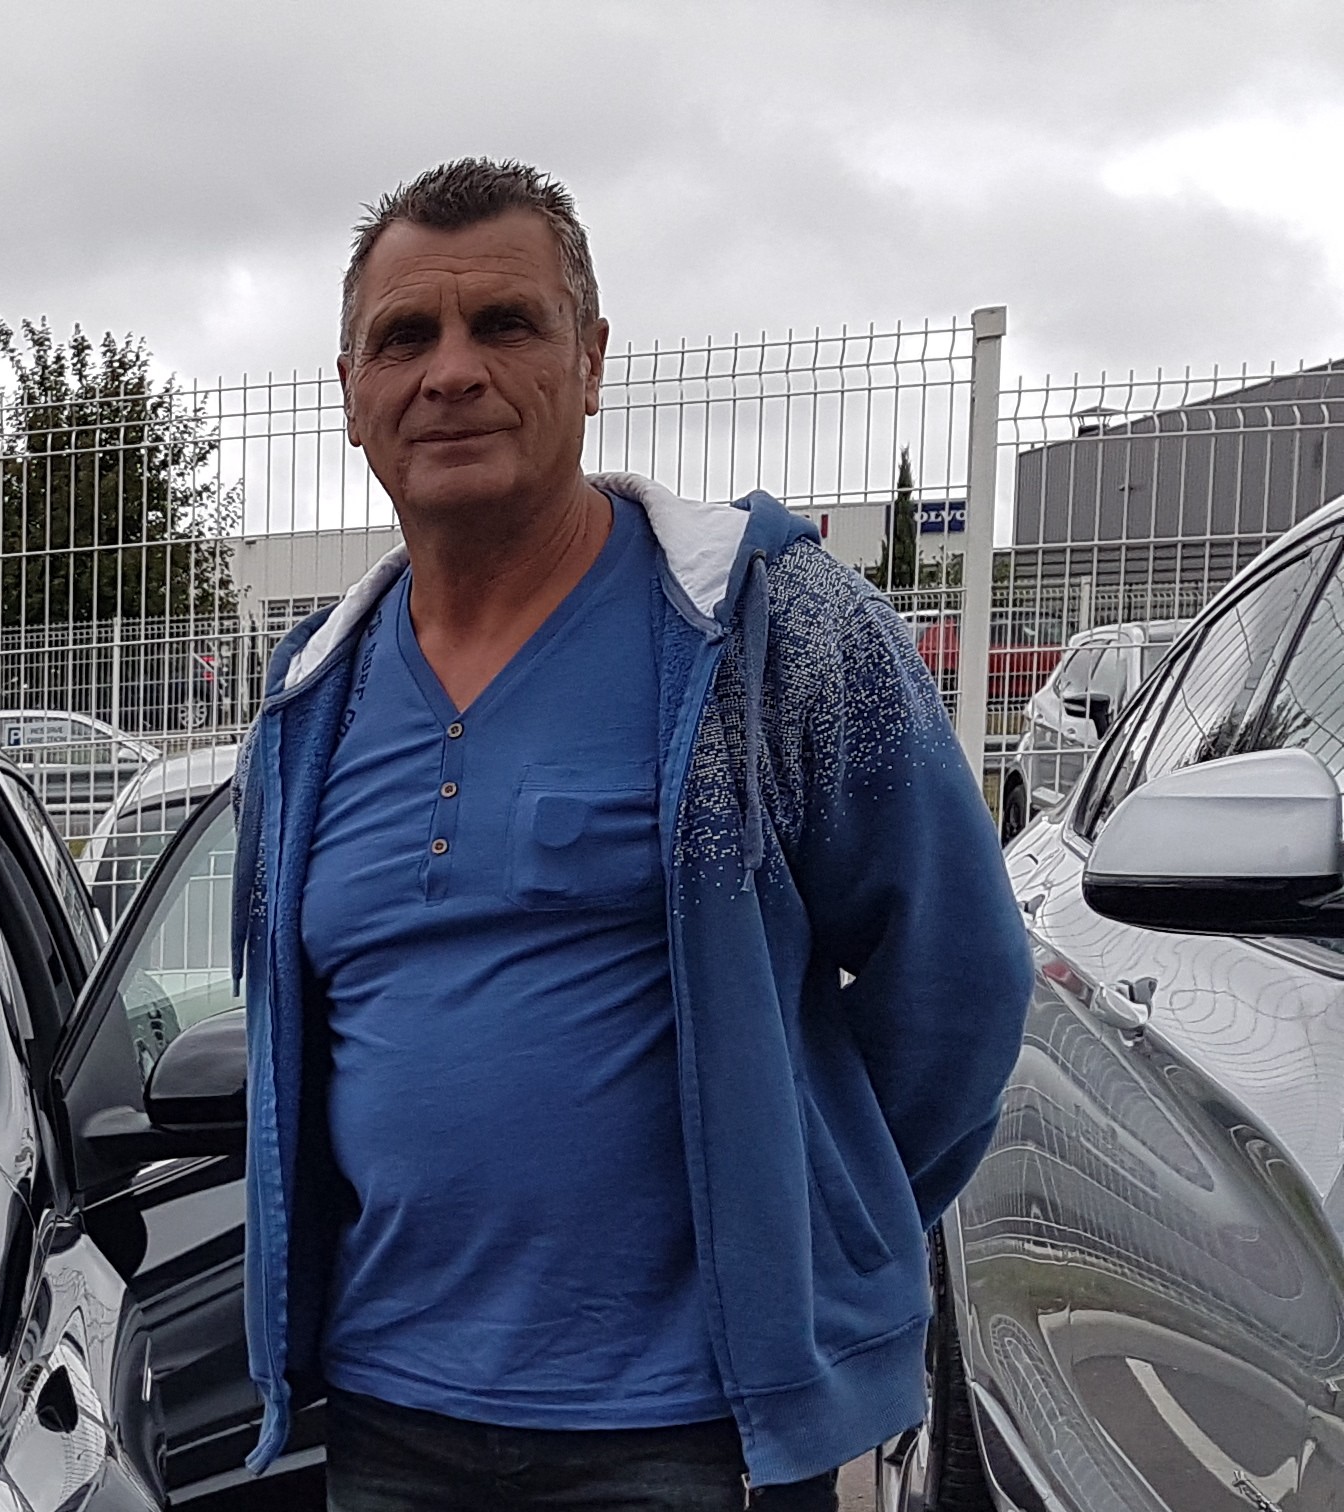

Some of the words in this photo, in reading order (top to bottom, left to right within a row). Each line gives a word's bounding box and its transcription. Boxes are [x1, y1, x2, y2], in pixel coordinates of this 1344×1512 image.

[914, 509, 967, 524] OLVO
[30, 726, 63, 735] RESRVE
[27, 735, 68, 744] DIRETION
